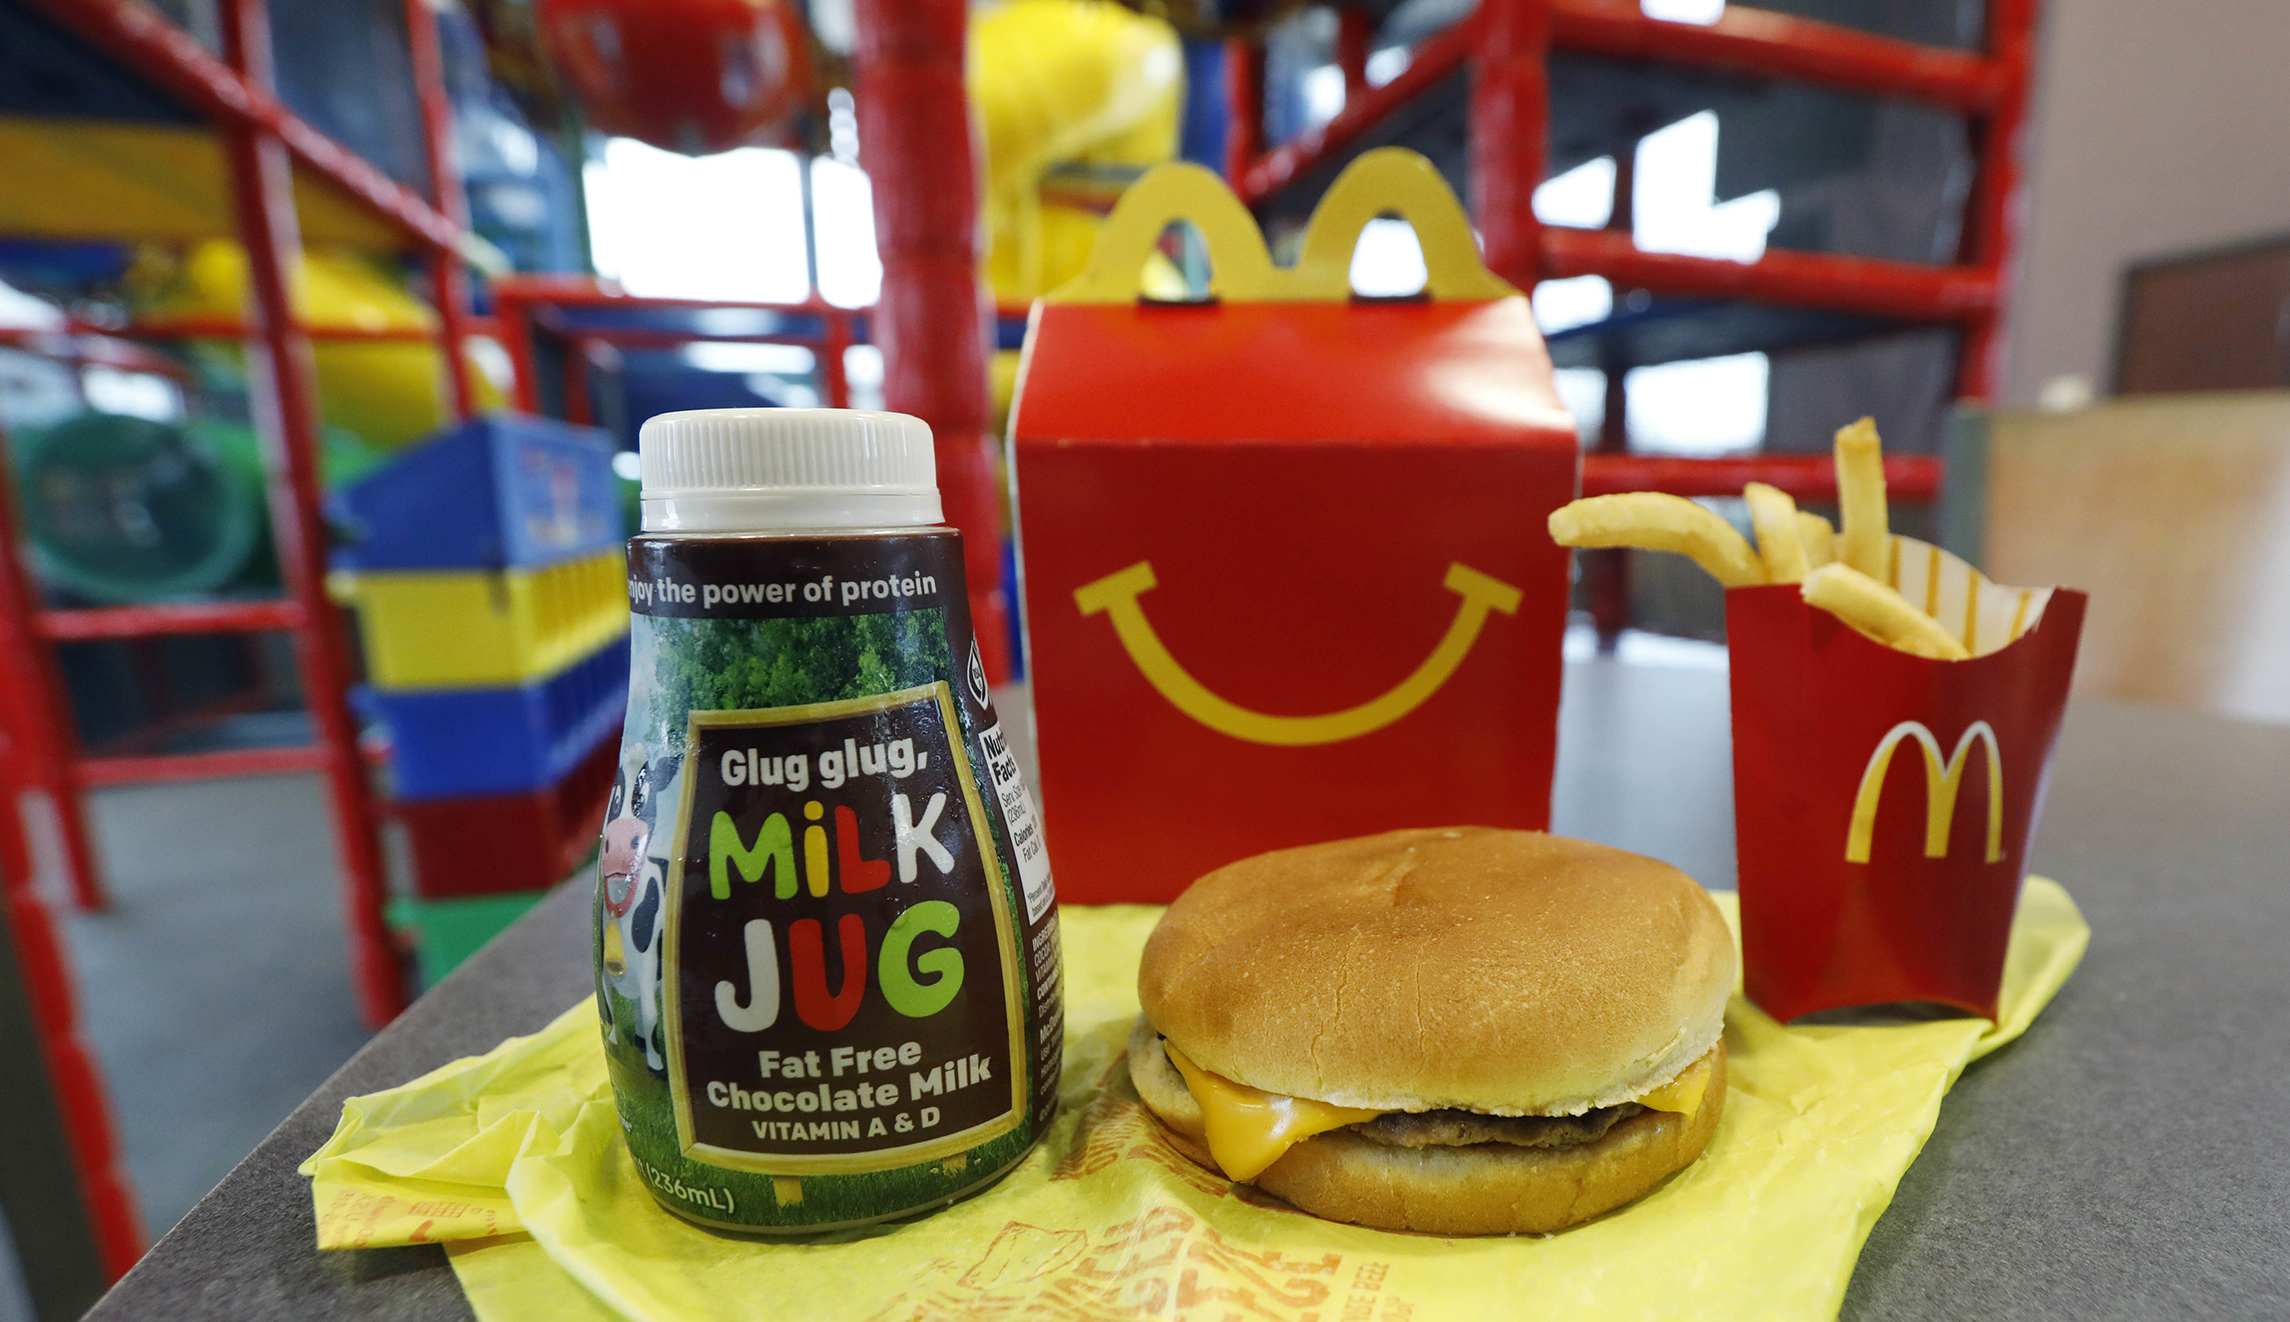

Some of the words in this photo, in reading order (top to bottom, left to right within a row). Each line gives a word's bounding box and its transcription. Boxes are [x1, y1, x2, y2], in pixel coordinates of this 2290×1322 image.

[657, 577, 696, 603] the
[703, 579, 796, 608] power
[803, 575, 833, 603] of
[842, 571, 937, 606] protein
[721, 748, 808, 792] Glug
[818, 737, 929, 790] glug,
[991, 753, 1018, 786] Facts
[1013, 822, 1035, 847] Calories
[714, 900, 965, 1033] JUG
[758, 1048, 822, 1079] Fat
[830, 1040, 923, 1076] Free
[706, 1080, 900, 1113] Chocolate
[909, 1053, 992, 1102] Milk
[752, 1119, 861, 1141] VITAMIN
[866, 1117, 886, 1139] A
[894, 1110, 915, 1132] &
[921, 1105, 941, 1128] D
[646, 1162, 736, 1214] (236mL)
